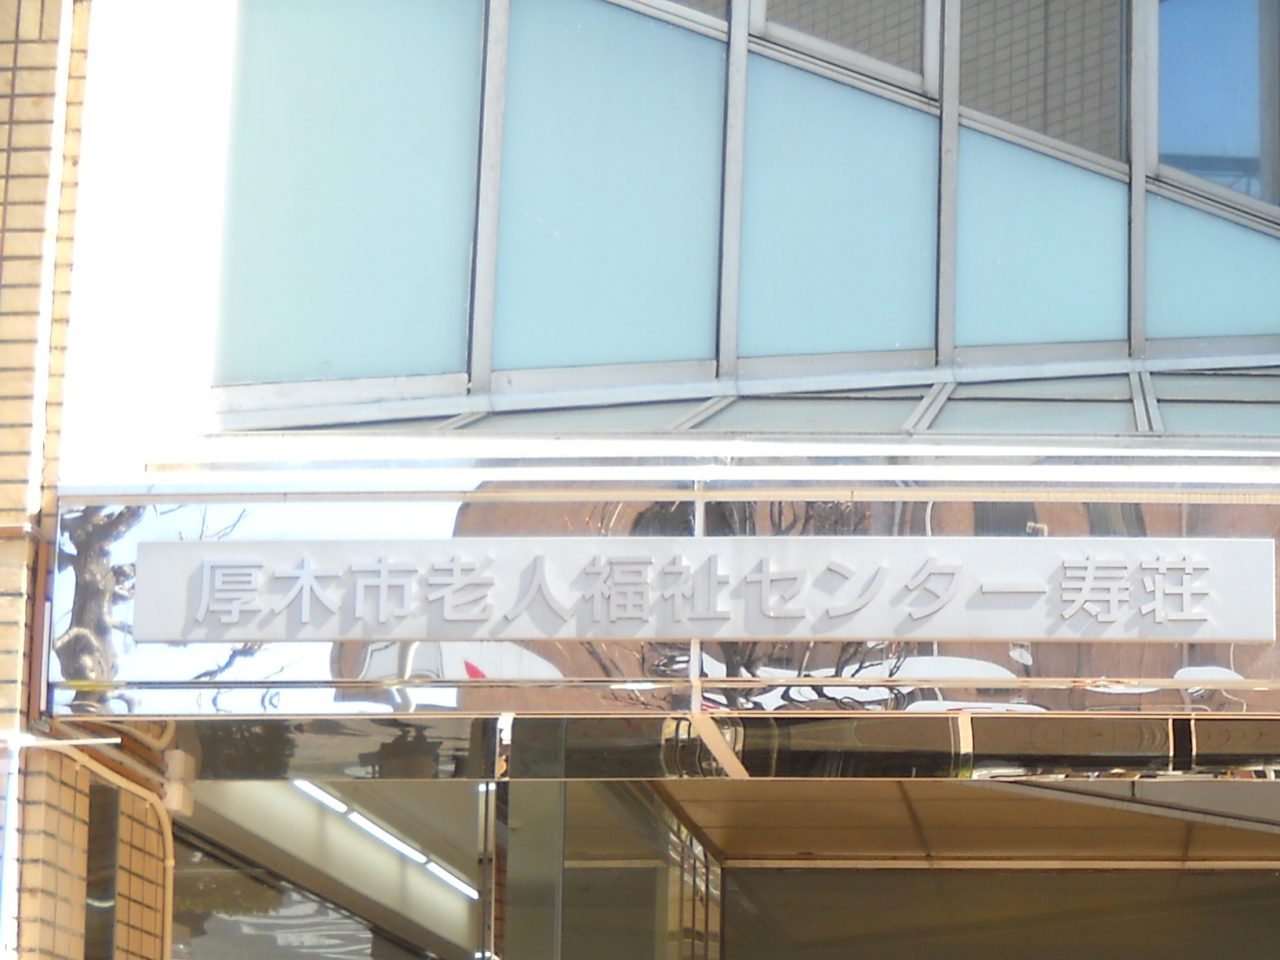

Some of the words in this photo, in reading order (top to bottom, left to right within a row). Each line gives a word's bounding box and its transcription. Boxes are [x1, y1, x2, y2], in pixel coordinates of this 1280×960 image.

[195, 553, 1211, 625] 厚木市老人福祉センター寿荘
